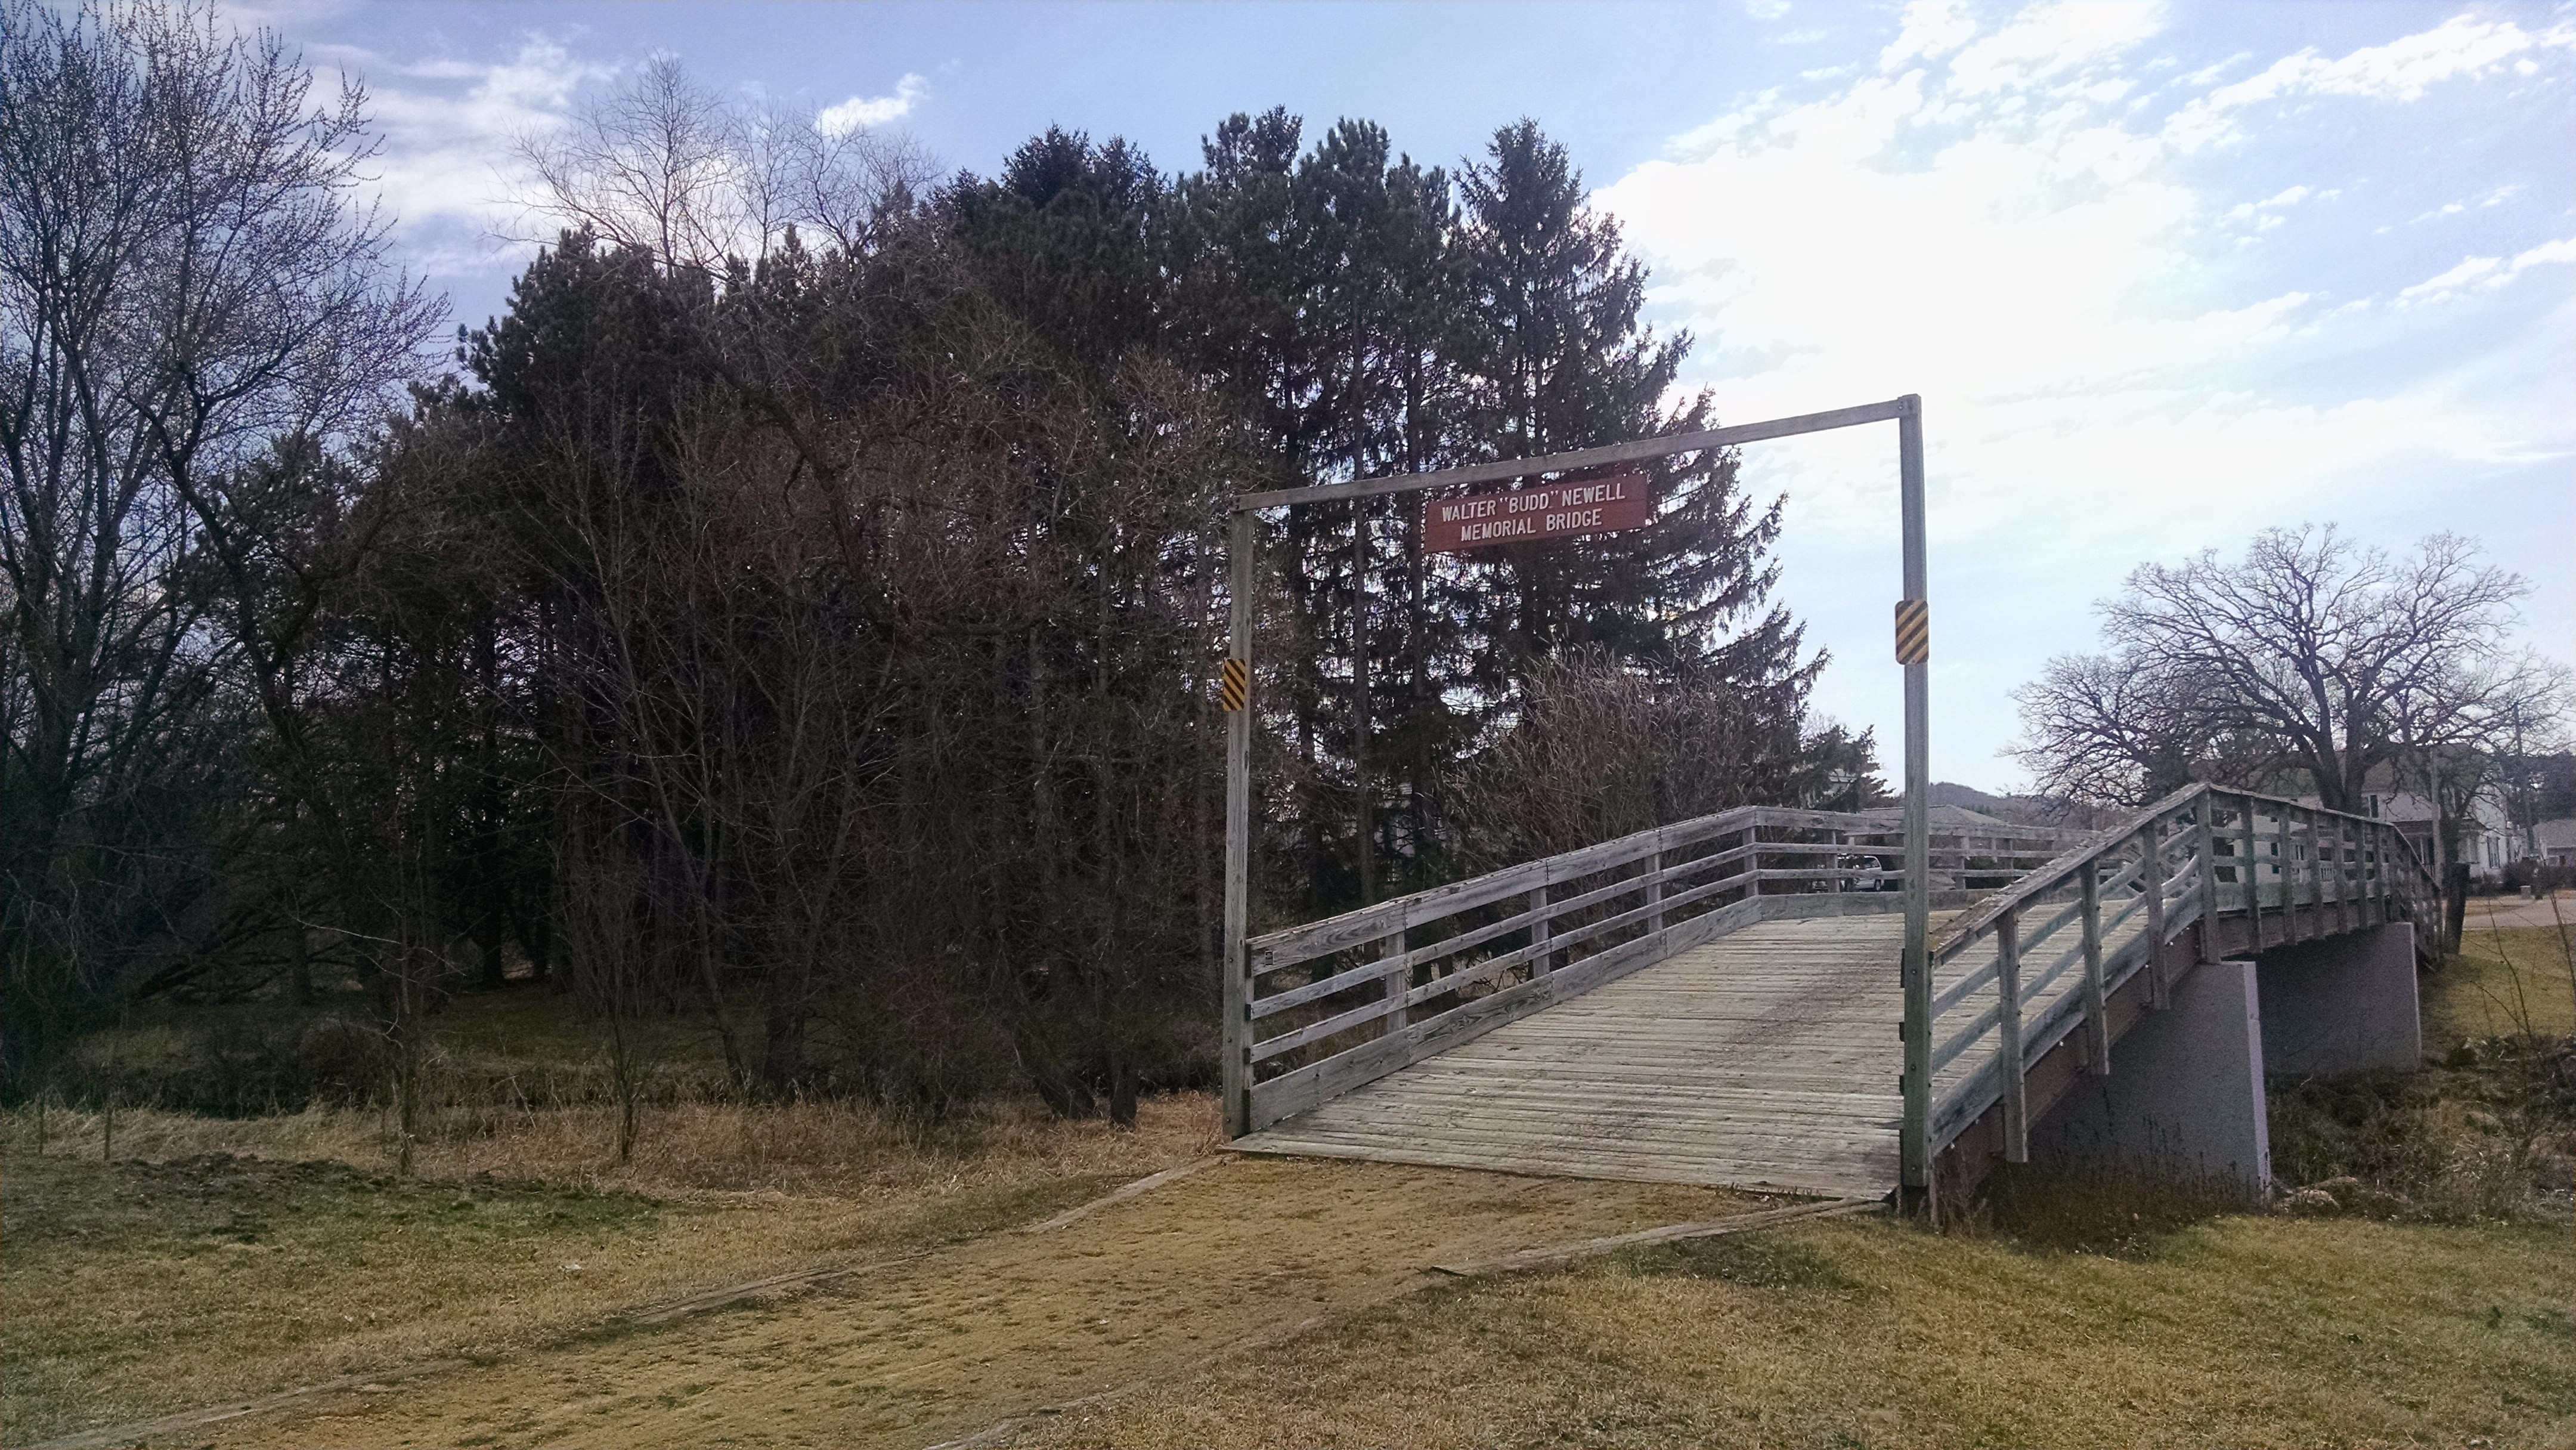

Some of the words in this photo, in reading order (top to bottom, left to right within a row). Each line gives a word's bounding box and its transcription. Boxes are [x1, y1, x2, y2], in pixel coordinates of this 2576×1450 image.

[1442, 500, 1496, 522] WALTER
[1562, 483, 1626, 507] NEWELL
[1461, 517, 1537, 542] MEMORIAL
[1546, 508, 1603, 531] BRIDGE
